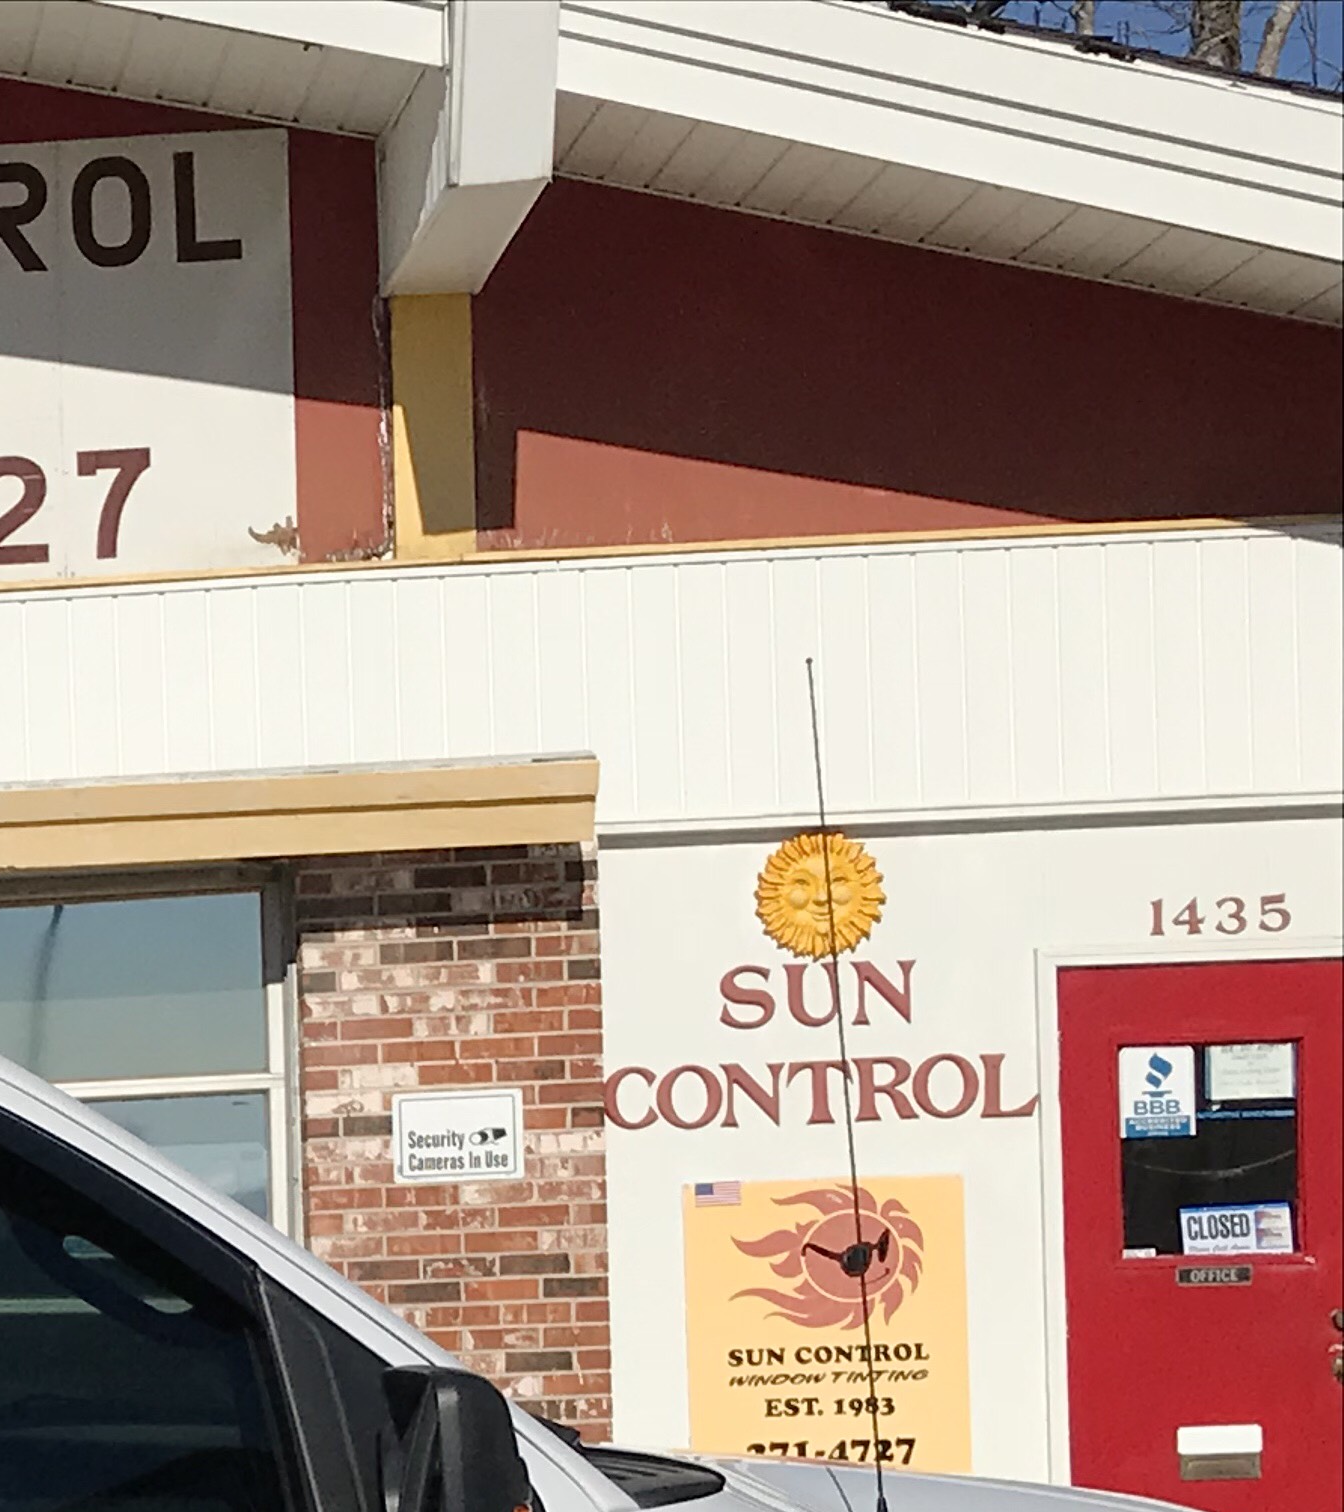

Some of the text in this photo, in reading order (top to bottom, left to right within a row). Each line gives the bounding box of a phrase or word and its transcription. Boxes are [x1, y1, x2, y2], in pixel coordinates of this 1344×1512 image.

[1149, 892, 1292, 937] 1435
[719, 959, 917, 1030] SUN
[603, 1053, 1042, 1130] CONTROL
[1134, 1099, 1181, 1116] BBB
[408, 1129, 465, 1150] Security
[408, 1150, 509, 1172] Cameras In Use
[1187, 1212, 1251, 1241] CLOSED
[1189, 1268, 1239, 1282] OFFICE
[727, 1342, 930, 1367] SUN CONTROL
[728, 1368, 929, 1387] WINDOW TINTING
[764, 1396, 896, 1418] EST. 1983
